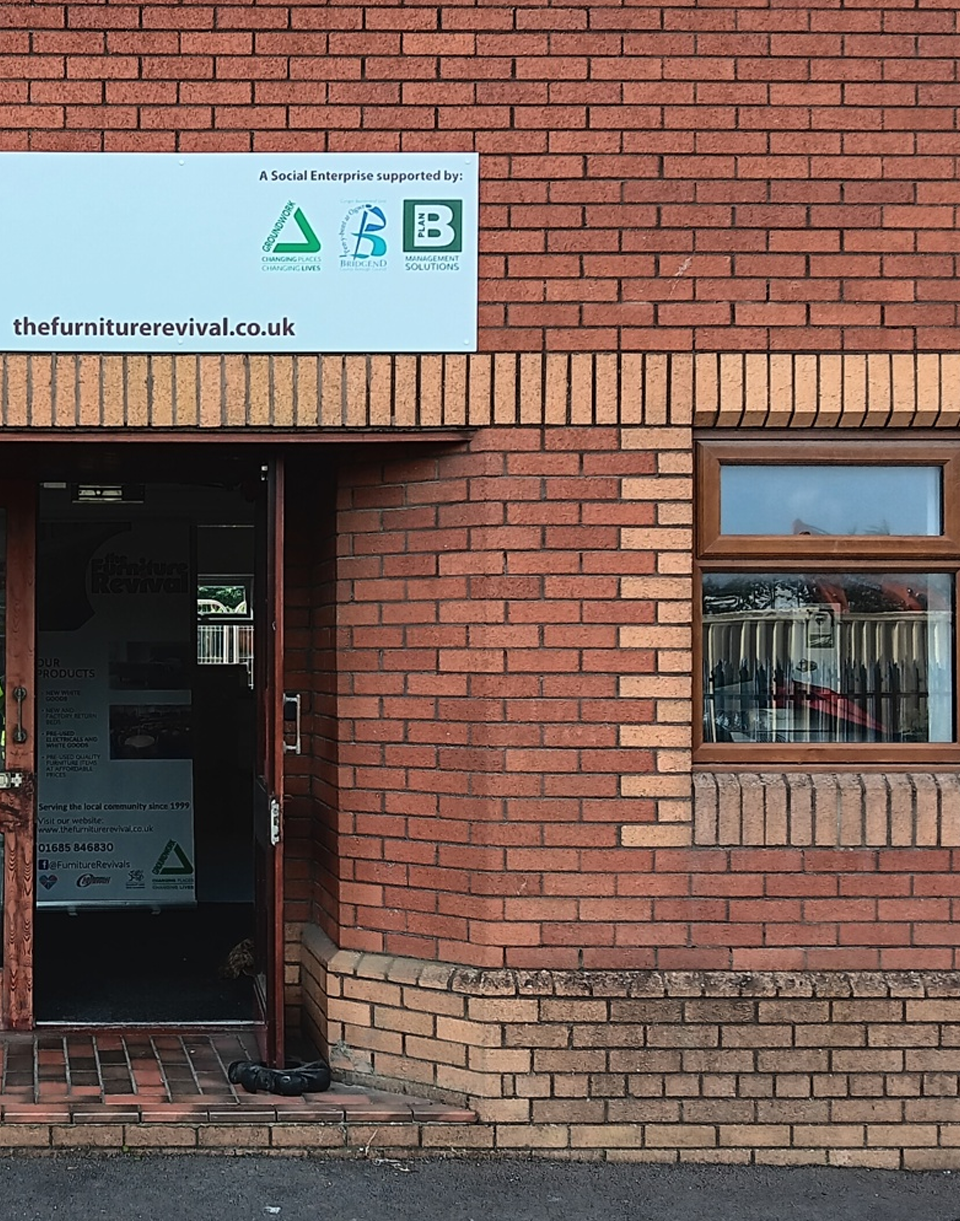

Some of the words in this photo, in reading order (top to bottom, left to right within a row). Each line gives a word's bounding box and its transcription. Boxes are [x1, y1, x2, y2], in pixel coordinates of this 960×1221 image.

[259, 171, 268, 181] A
[271, 170, 307, 181] Social
[311, 170, 374, 183] Enterprise
[376, 170, 441, 183] supported
[443, 170, 463, 183] by:
[261, 200, 296, 252] GROUNDWORK
[13, 316, 295, 338] thefurniturerevival.co.uk
[91, 558, 188, 575] Furniture
[91, 572, 188, 593] Revival
[38, 803, 67, 811] Serving
[104, 802, 146, 811] community
[148, 802, 168, 810] since
[170, 801, 190, 810] 1999
[38, 843, 71, 852] 01685
[74, 843, 114, 852] 846830
